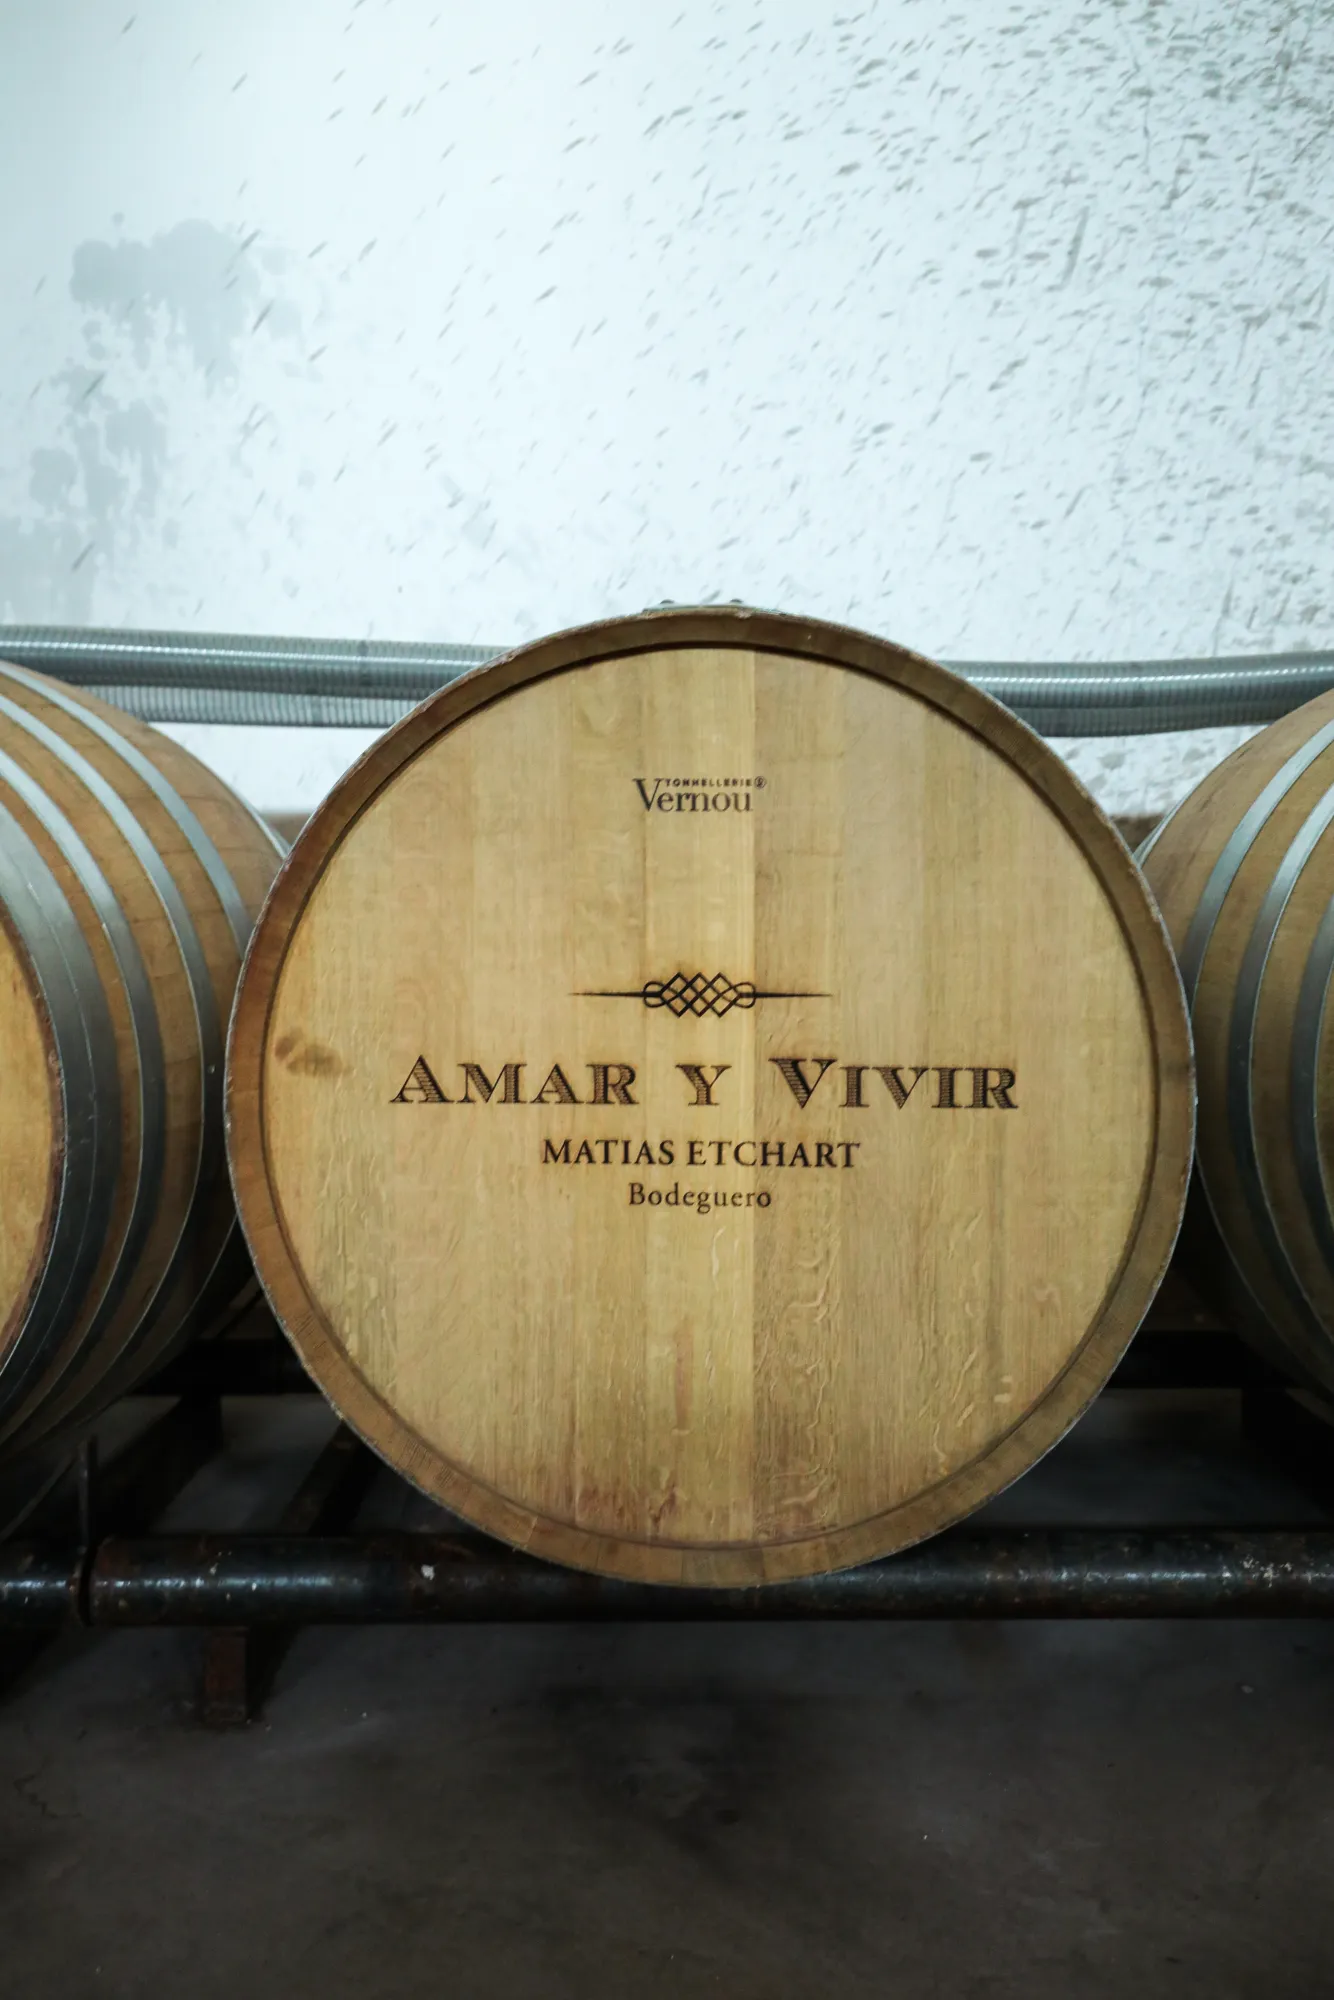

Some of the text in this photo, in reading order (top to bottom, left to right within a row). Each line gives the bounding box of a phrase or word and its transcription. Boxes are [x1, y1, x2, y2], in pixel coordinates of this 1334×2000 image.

[632, 778, 753, 812] Vernou
[391, 1055, 1018, 1109] AMAR Y VIVIR
[542, 1139, 860, 1168] MATIAS ETCHART
[629, 1183, 773, 1214] Bodeguero
